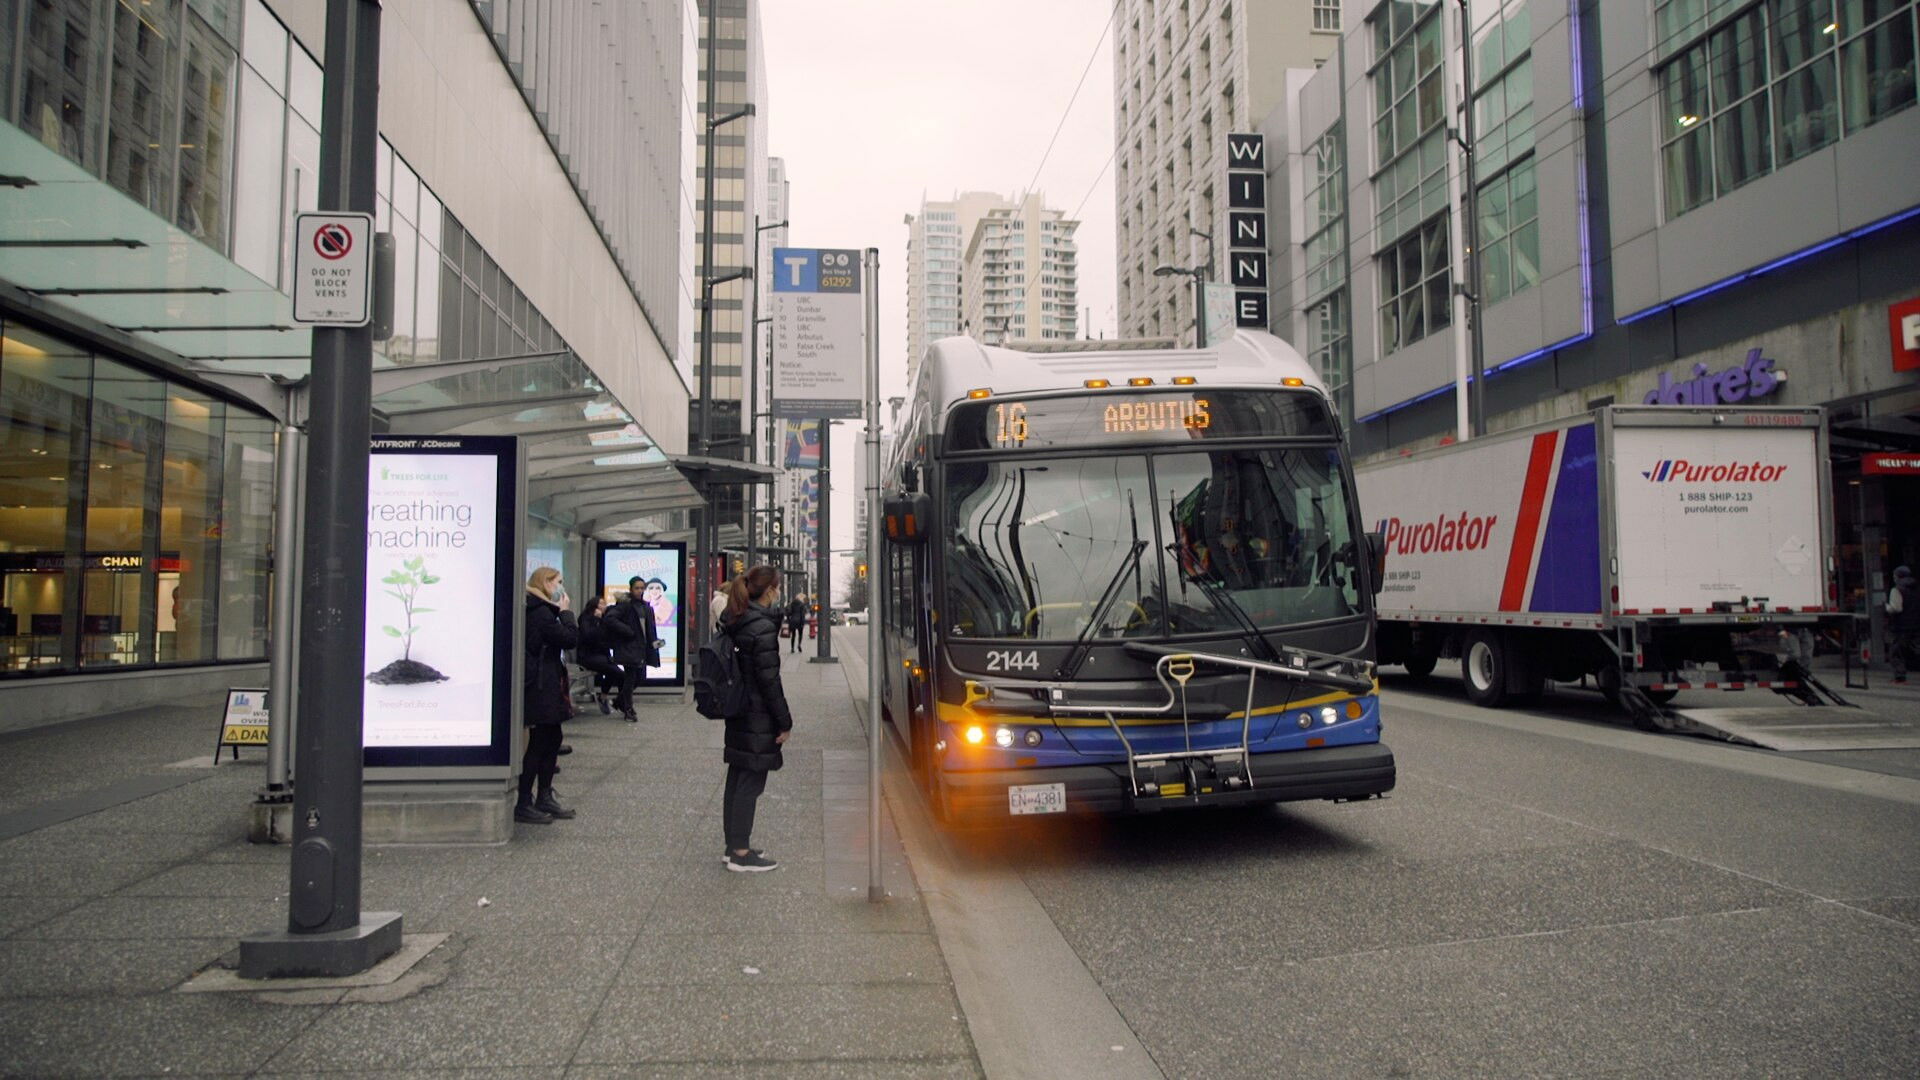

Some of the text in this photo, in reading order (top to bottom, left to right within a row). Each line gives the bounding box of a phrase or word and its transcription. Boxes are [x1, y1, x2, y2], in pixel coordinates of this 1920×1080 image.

[311, 268, 351, 277] DO NOT
[784, 257, 808, 286] T
[315, 279, 348, 287] BLOCK
[822, 276, 852, 287] 61292
[315, 289, 347, 298] VENTS
[797, 296, 811, 304] UBC
[797, 305, 821, 313] Dunbar
[797, 333, 823, 341] Arbutus
[995, 399, 1210, 441] 16 ARBUTUS
[1668, 460, 1787, 482] Purolator
[391, 473, 448, 481] TREES FOR LIFE
[1679, 492, 1753, 501] 1 888 SHIP-123
[368, 500, 472, 527] reathing
[1684, 504, 1748, 514] purolator.com
[1384, 511, 1497, 556] Purolator
[986, 651, 1040, 671] 2144
